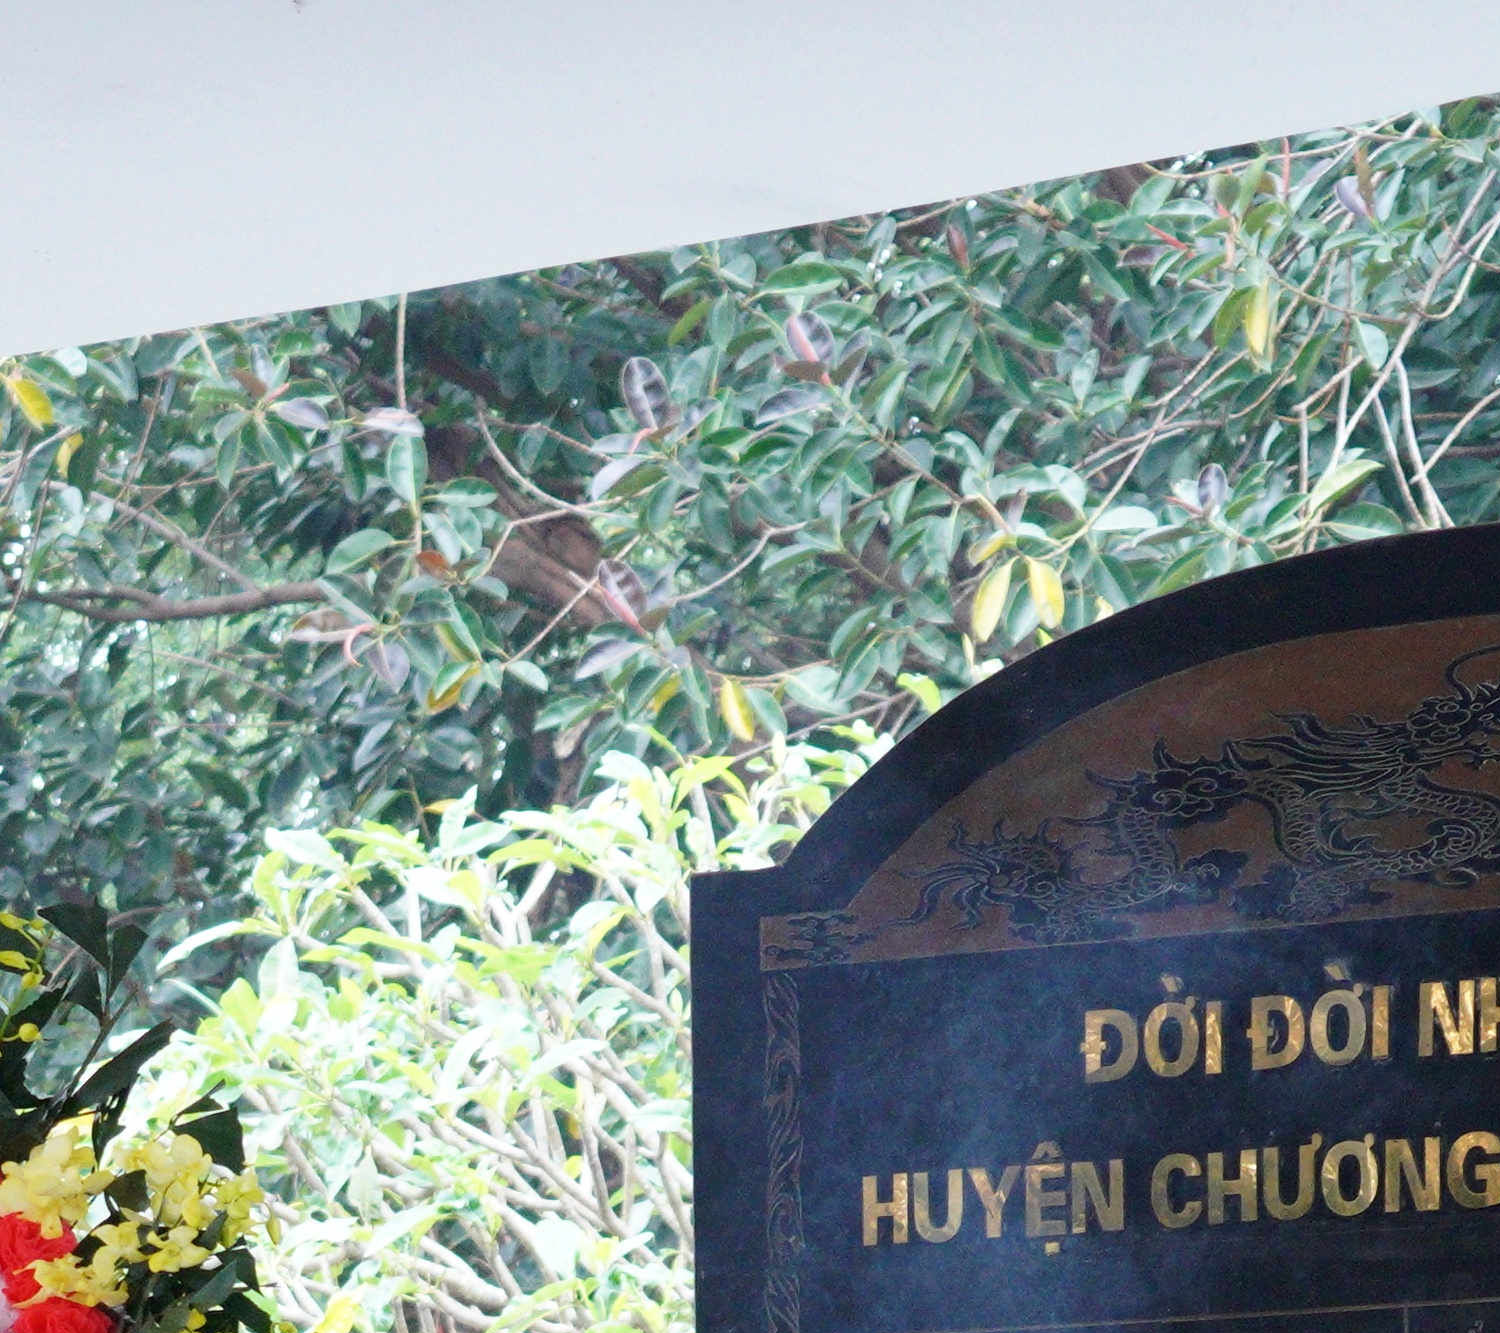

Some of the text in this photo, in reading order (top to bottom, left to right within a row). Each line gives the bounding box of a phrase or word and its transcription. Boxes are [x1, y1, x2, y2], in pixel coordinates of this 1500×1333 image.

[1080, 973, 1222, 1084] ĐỜI
[1247, 963, 1393, 1071] ĐỜI
[862, 1141, 1124, 1255] HUYỆN
